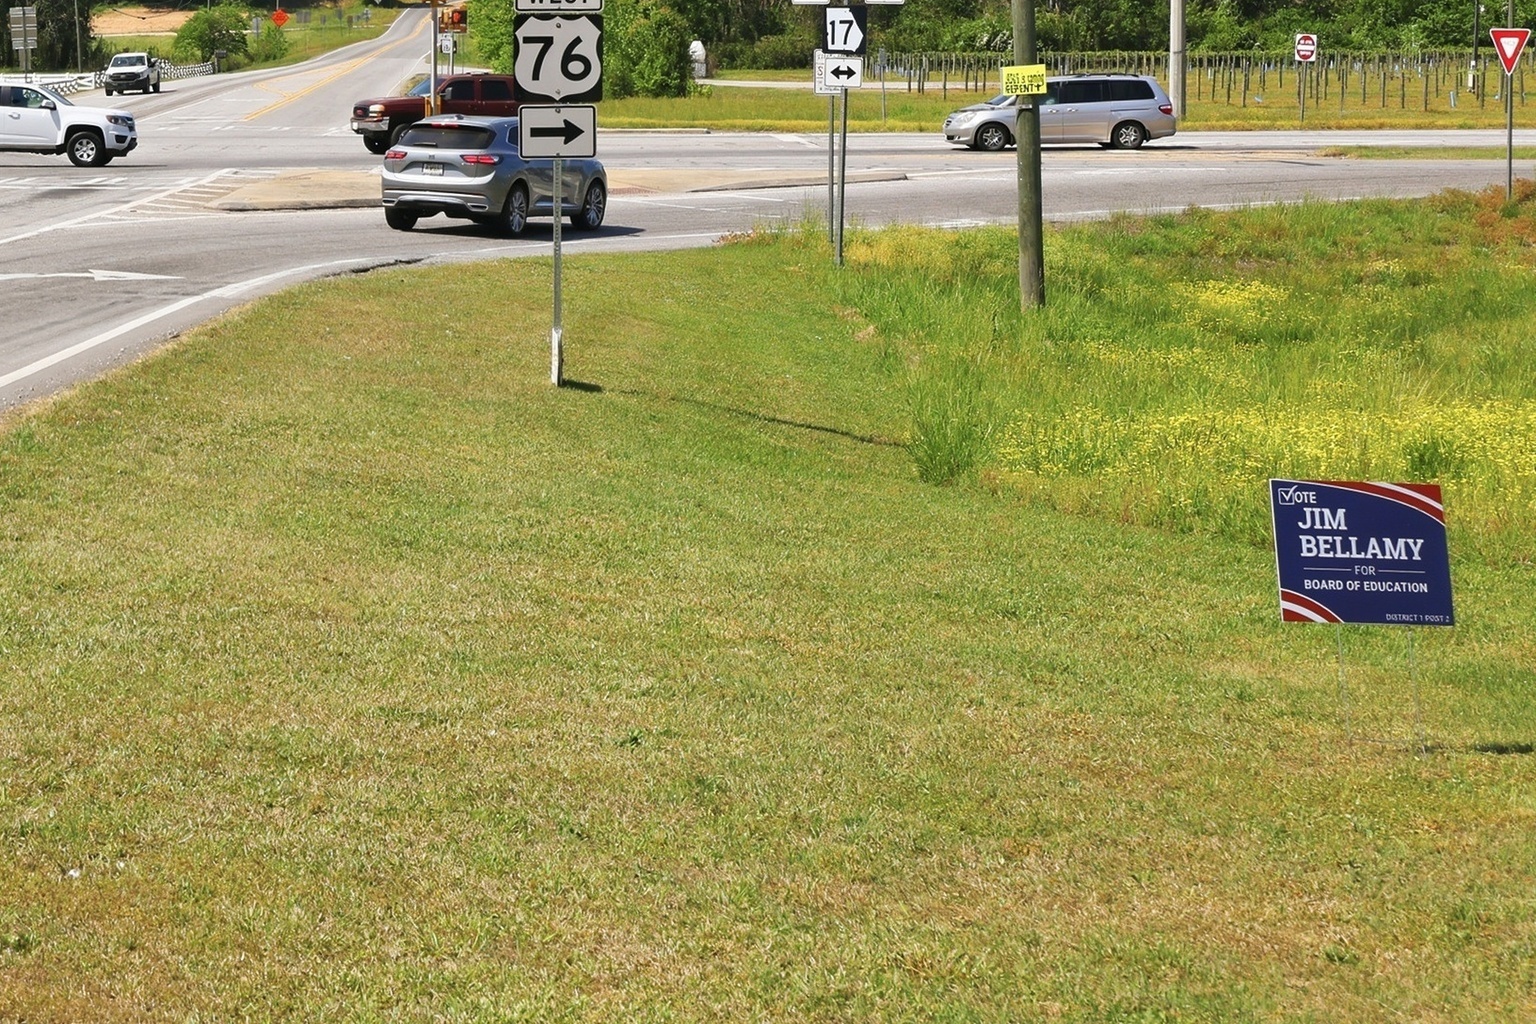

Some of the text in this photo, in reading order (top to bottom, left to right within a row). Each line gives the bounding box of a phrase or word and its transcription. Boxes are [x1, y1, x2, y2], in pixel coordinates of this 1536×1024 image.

[829, 19, 854, 45] 17
[522, 36, 592, 81] 76
[1297, 507, 1347, 530] JIM
[1299, 535, 1424, 560] BELLAMY
[1354, 565, 1376, 576] FOR
[1304, 579, 1428, 593] BOARD OF EDUCATION
[1385, 613, 1418, 621] DISTRICT
[1424, 614, 1444, 622] POST
